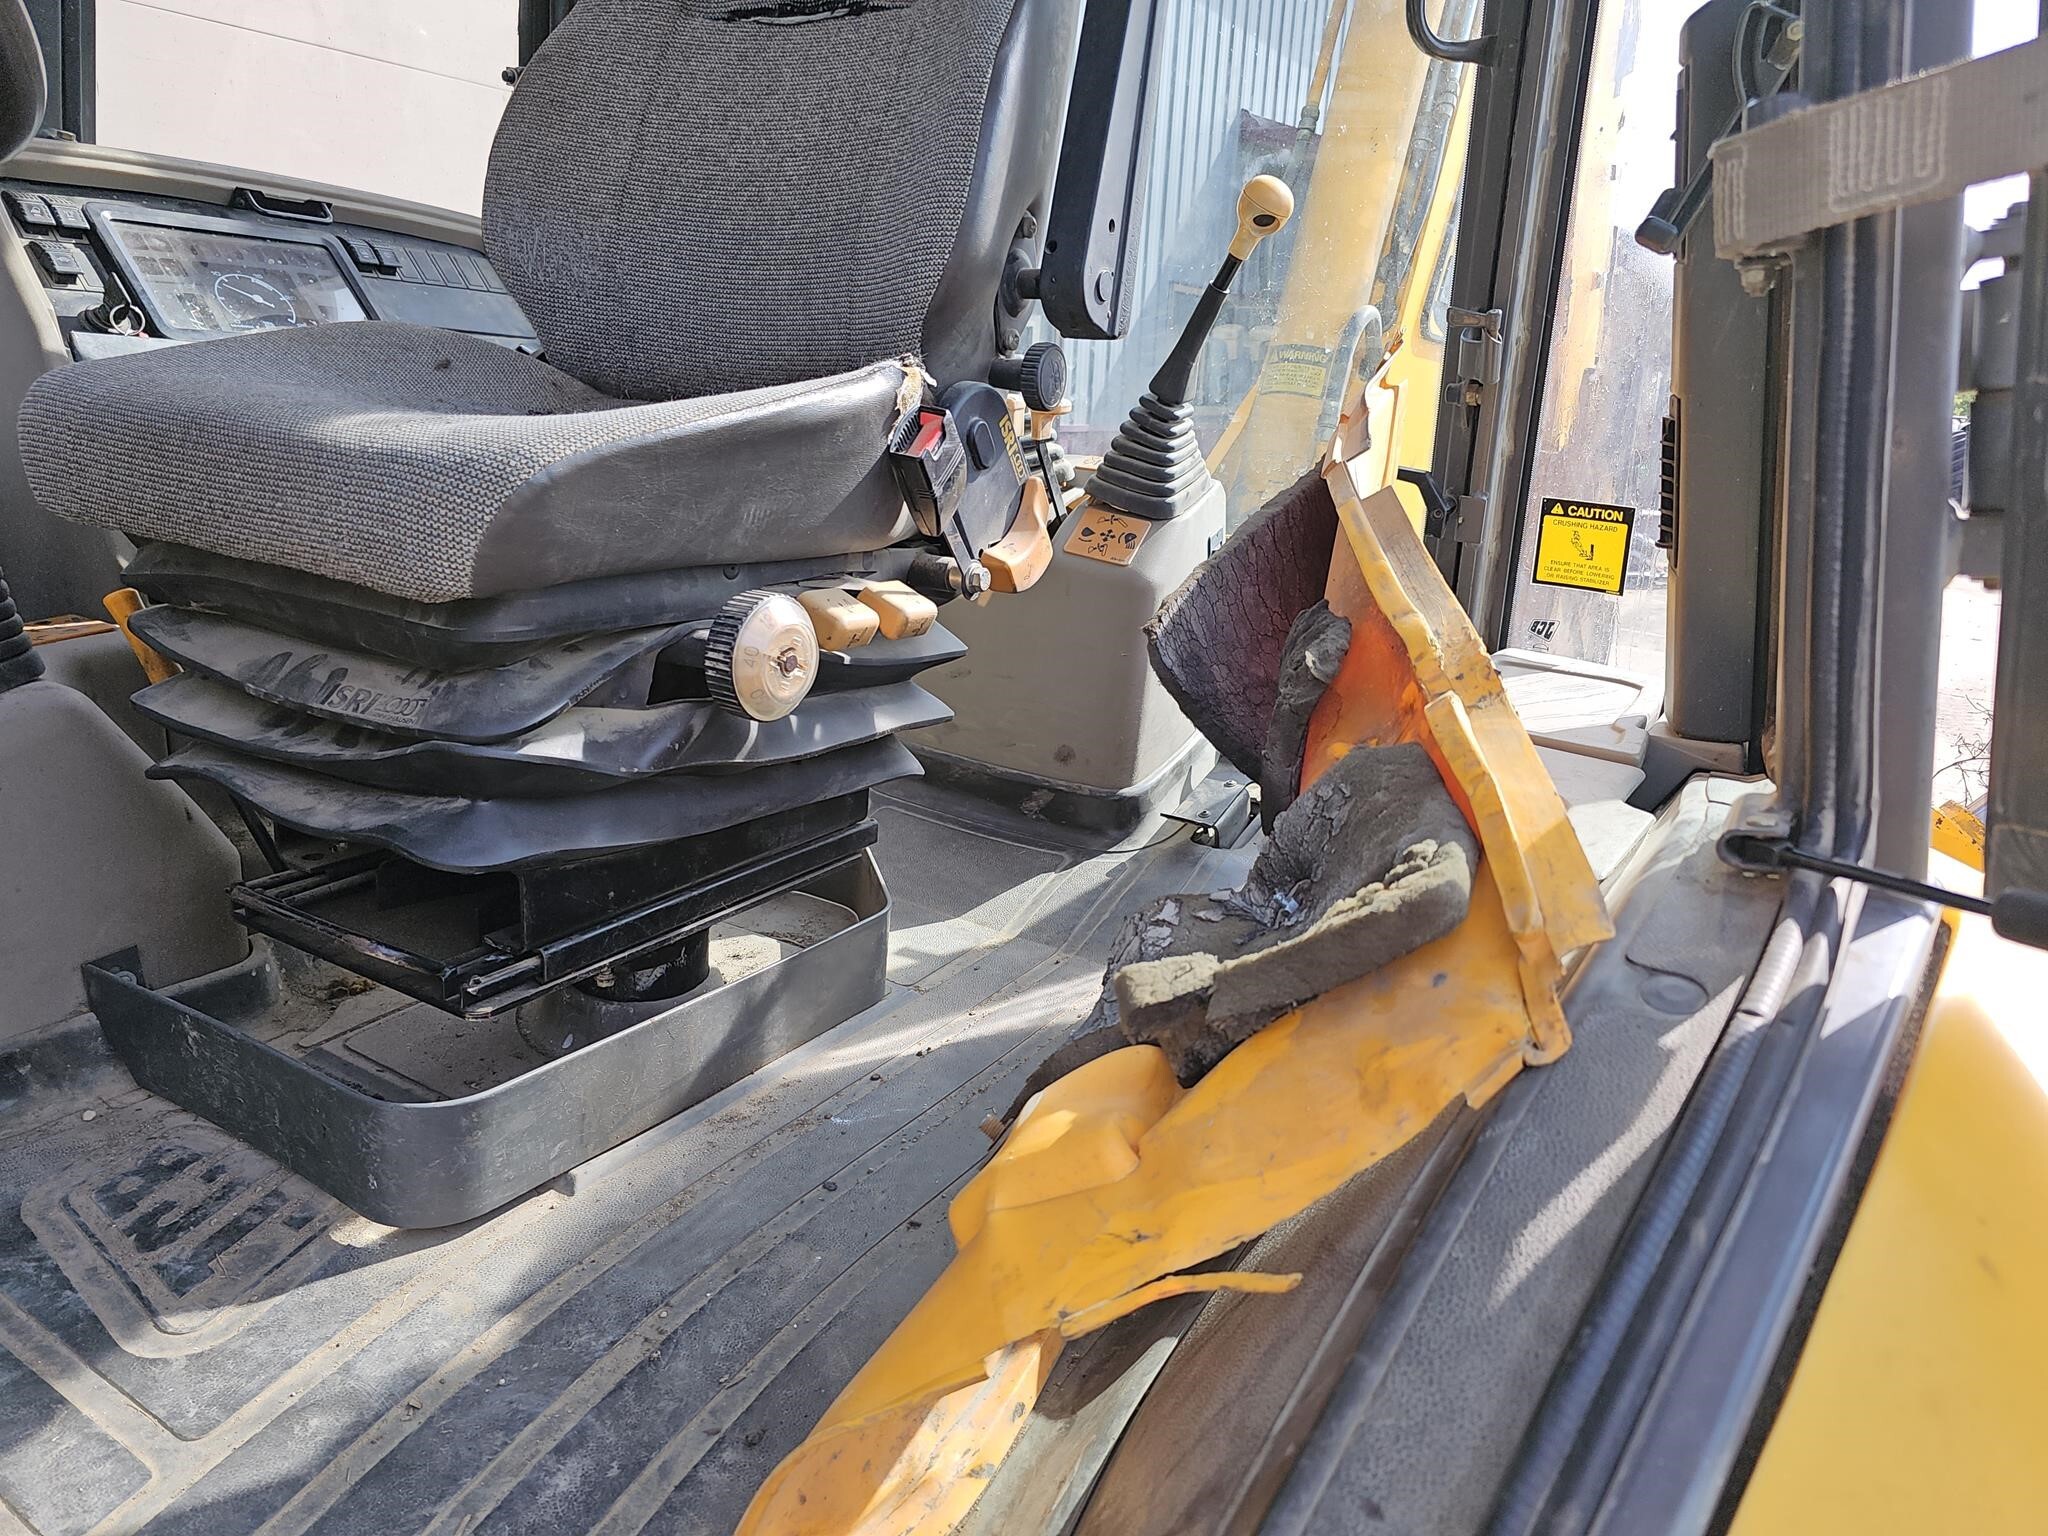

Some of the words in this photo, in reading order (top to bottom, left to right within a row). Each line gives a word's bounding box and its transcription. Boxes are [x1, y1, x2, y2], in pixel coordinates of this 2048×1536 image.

[1279, 350, 1329, 363] WARNING
[998, 414, 1019, 457] ISRI
[1567, 505, 1624, 522] CAUTION
[1552, 518, 1588, 530] CRUSHING
[1589, 523, 1618, 533] HAZARD
[1543, 565, 1561, 573] CLEAR
[1563, 568, 1584, 576] BEFORE
[1586, 571, 1615, 581] LOWERING
[1550, 559, 1571, 568] ENSURE
[1573, 562, 1587, 570] THAT
[1587, 564, 1602, 572] AREA
[1555, 573, 1578, 582] RAISING
[1579, 577, 1610, 586] STABILIZER
[319, 684, 383, 714] ISRI
[95, 1146, 316, 1300] JCB
